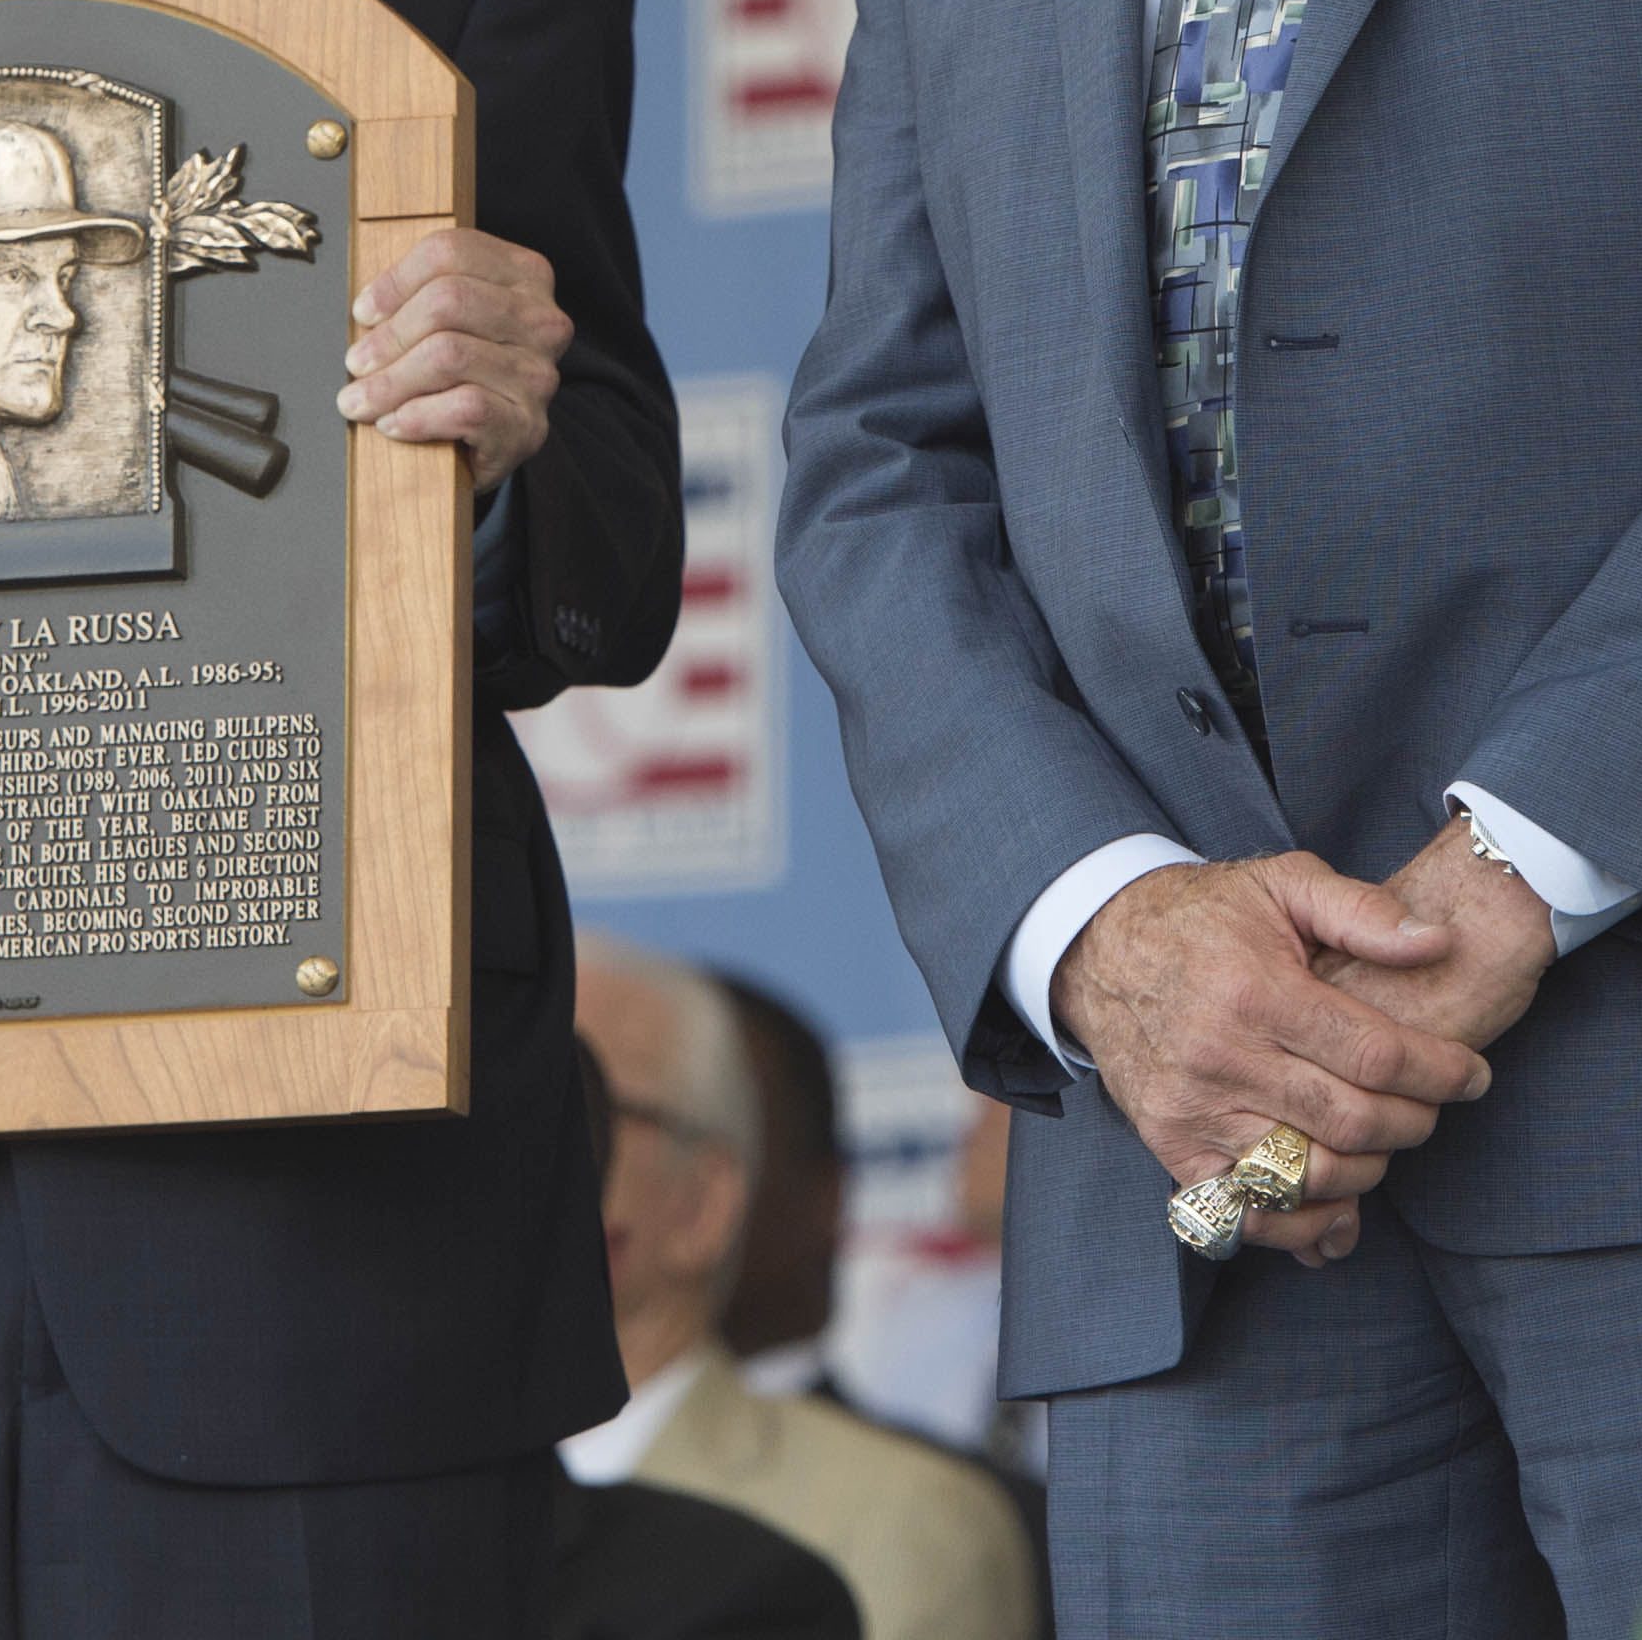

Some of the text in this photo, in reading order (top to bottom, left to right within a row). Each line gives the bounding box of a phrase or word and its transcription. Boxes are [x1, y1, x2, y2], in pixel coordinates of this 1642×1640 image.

[10, 618, 57, 649] LA
[68, 611, 180, 646] RUSSA
[1, 670, 132, 698] OAKLAND,
[134, 667, 182, 691] A.L.
[190, 662, 282, 688] 1986-95;
[40, 690, 147, 715] 1996-2011
[48, 726, 91, 750] AND
[99, 720, 205, 747] MANAGING
[214, 714, 320, 741] BULLPENS,
[115, 746, 172, 769] EVER.
[180, 743, 220, 766] LED
[227, 739, 289, 764] CLUBS
[294, 738, 321, 760] TO
[66, 771, 121, 796] (1989,
[128, 768, 177, 793] 2006,
[184, 765, 233, 788] 2011)
[238, 763, 281, 785] AND
[288, 761, 320, 782] SIX
[100, 793, 151, 816] WITH
[160, 787, 256, 812] OAKLAND
[265, 784, 320, 807] FROM
[6, 822, 33, 843] OF
[44, 820, 84, 841] THE
[97, 816, 156, 839] YEAR,
[170, 811, 249, 835] BECAME
[264, 808, 321, 830] FIRST
[10, 846, 32, 867] IN
[40, 843, 91, 865] BOTH
[99, 838, 188, 862] LEAGUES
[194, 835, 236, 857] AND
[242, 831, 321, 855] SECOND
[94, 864, 127, 885] HIS
[132, 861, 189, 883] GAME
[196, 860, 207, 880] 6
[214, 854, 320, 879] DIRECTION
[14, 887, 127, 913] CARDINALS
[145, 885, 173, 906] TO
[194, 877, 320, 903] IMPROBABLE
[42, 909, 143, 934] BECOMING
[151, 905, 230, 928] SECOND
[237, 900, 319, 924] SKIPPER
[87, 934, 125, 954] PRO
[129, 931, 201, 952] SPORTS
[206, 926, 291, 948] HISTORY.
